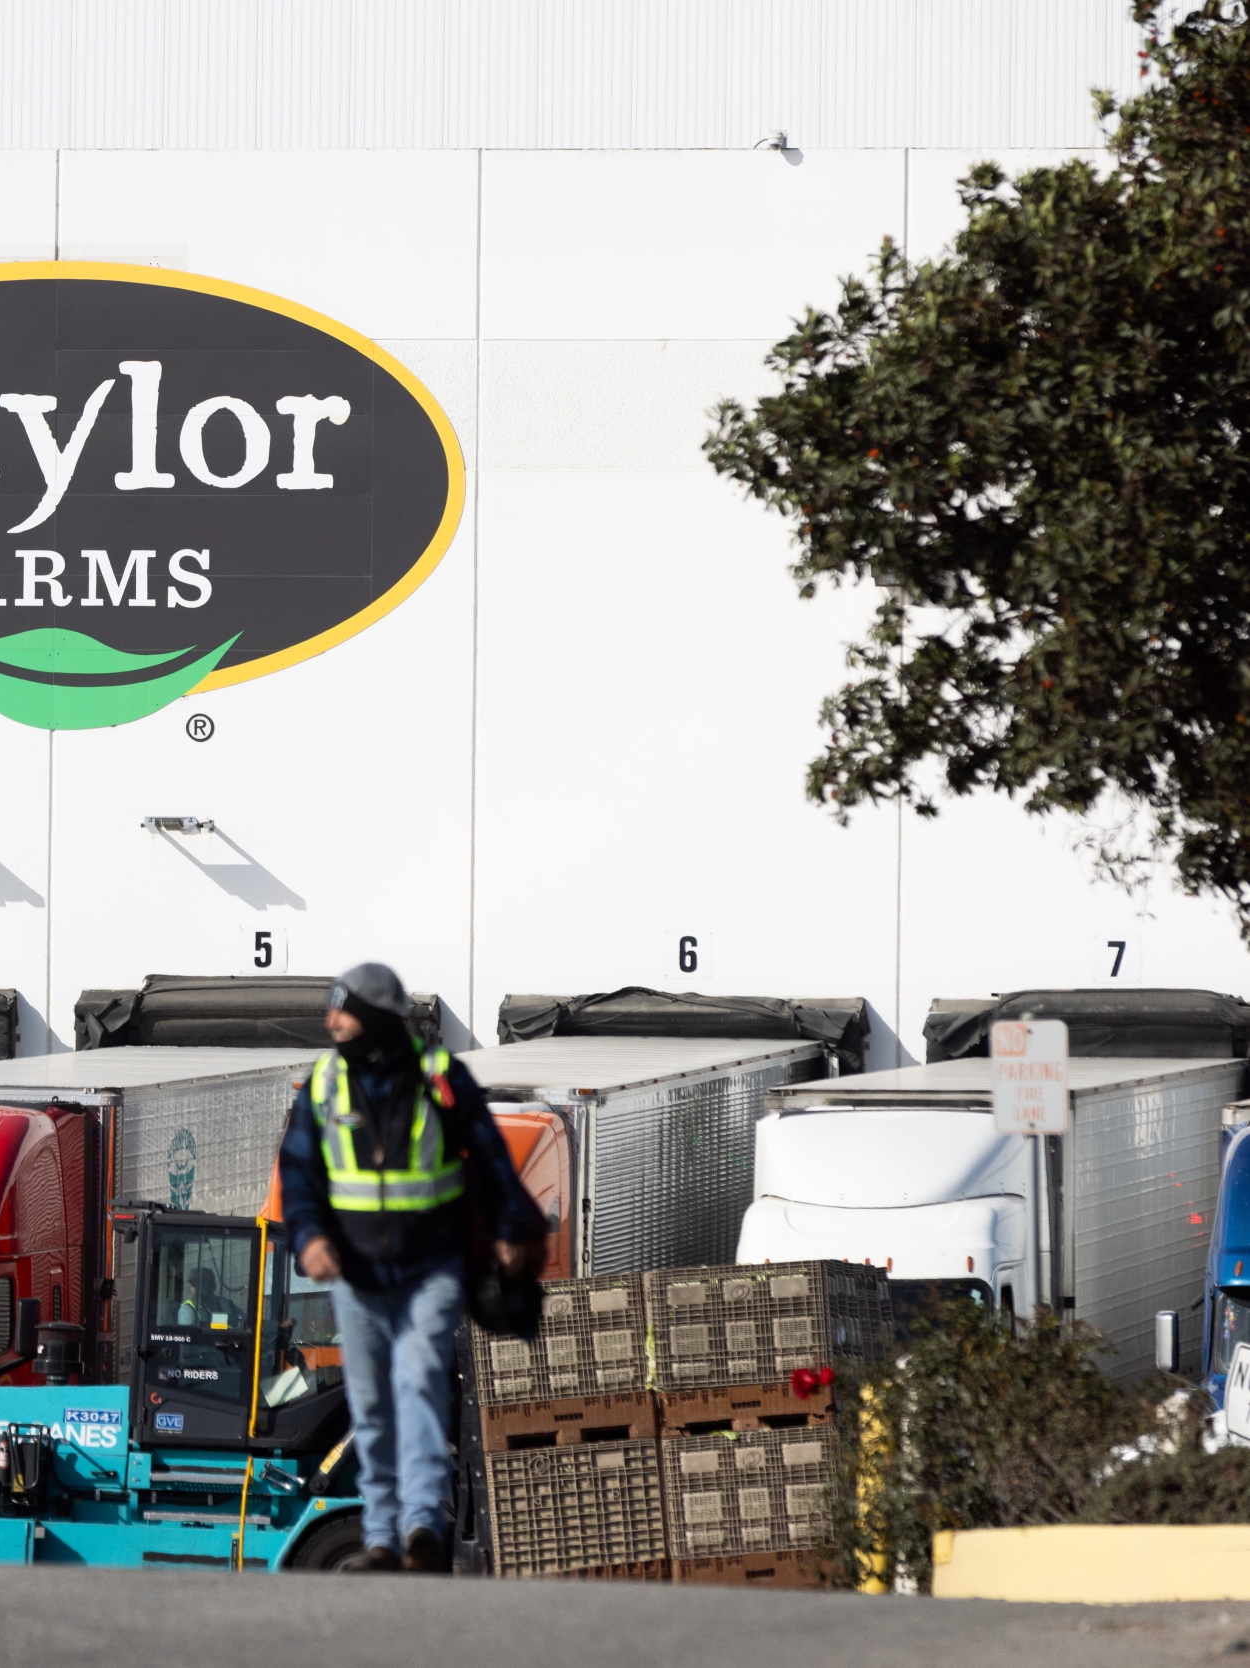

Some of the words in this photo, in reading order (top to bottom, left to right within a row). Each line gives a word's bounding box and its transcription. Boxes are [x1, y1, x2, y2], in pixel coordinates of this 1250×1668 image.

[254, 931, 273, 968] 5
[679, 935, 698, 973] 6
[1107, 940, 1127, 977] 7
[998, 1062, 1064, 1082] PARKING
[1016, 1086, 1044, 1102] FIRE
[1014, 1106, 1046, 1122] LANE
[167, 1369, 182, 1378] NO
[184, 1369, 218, 1380] RIDERS
[66, 1411, 119, 1423] K3047
